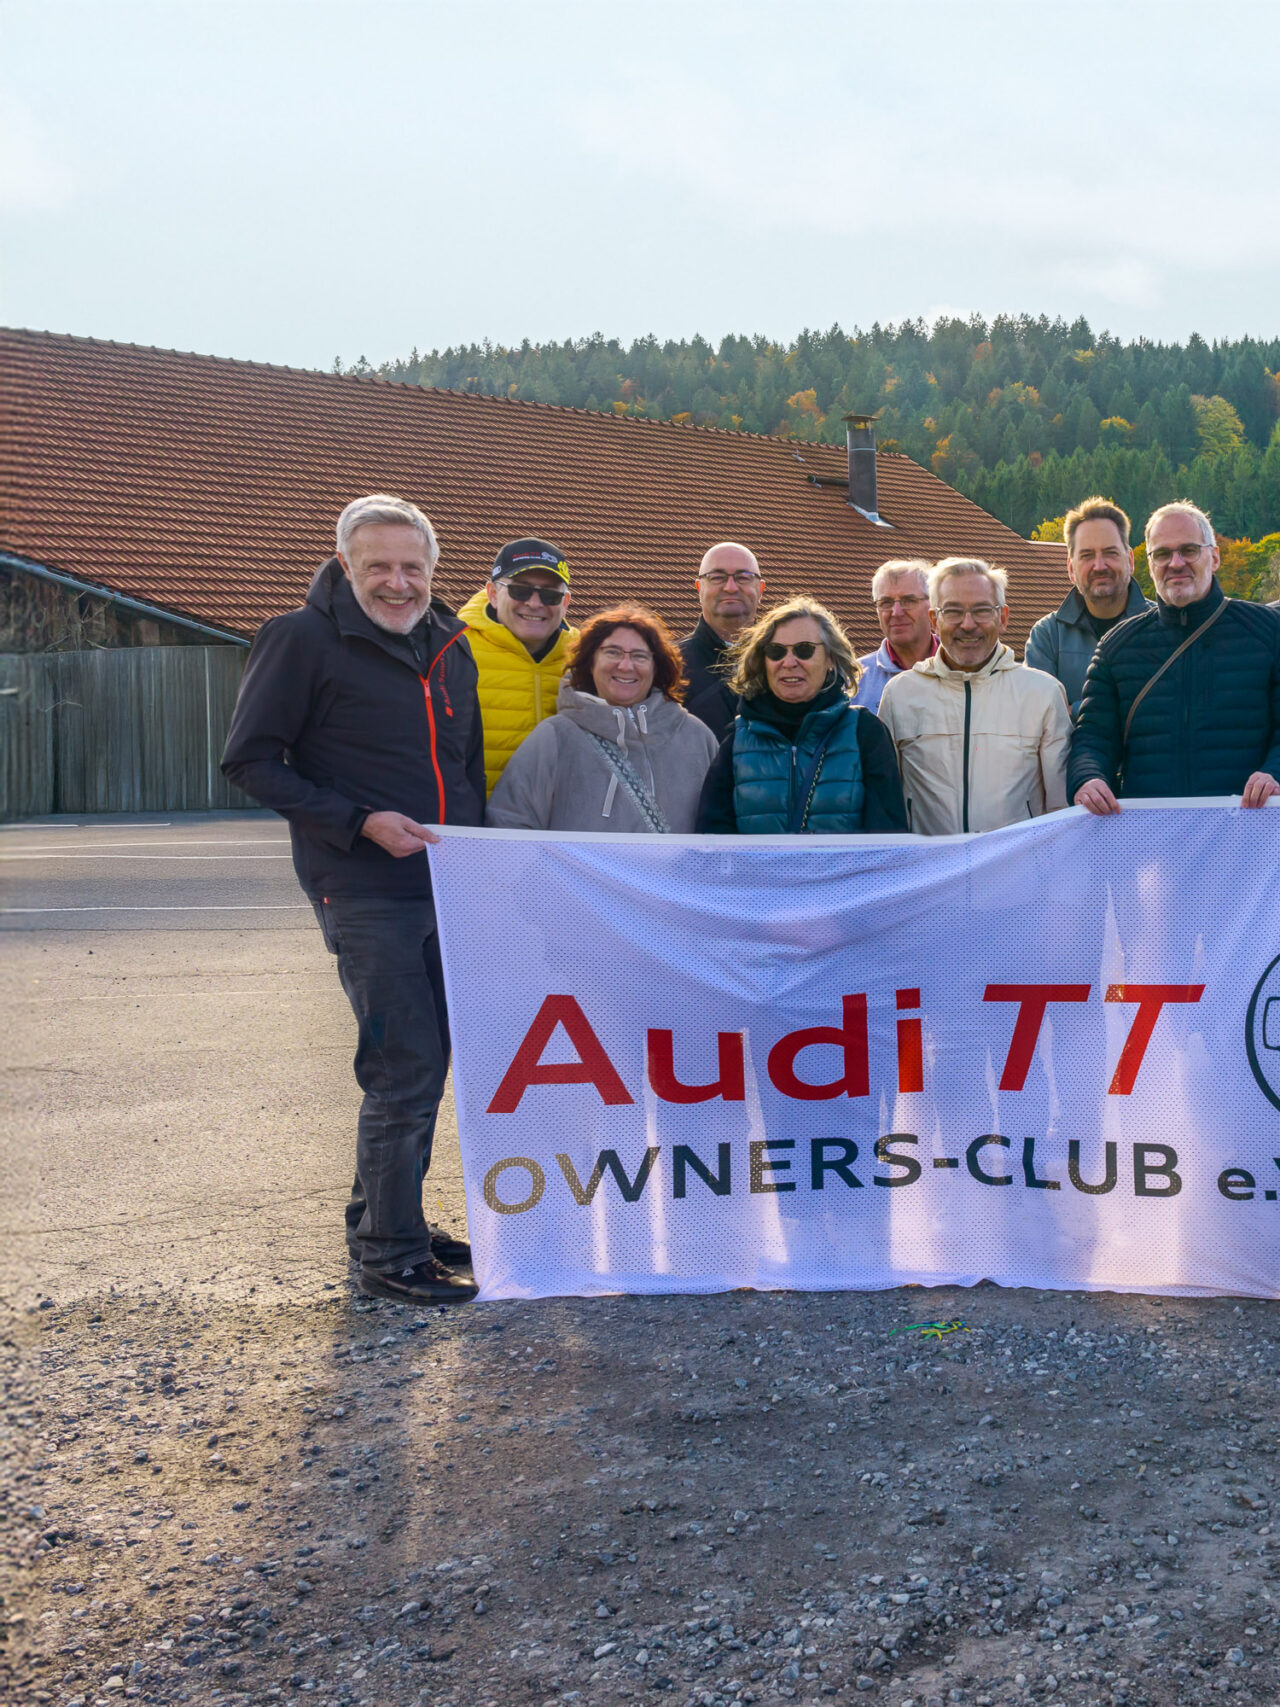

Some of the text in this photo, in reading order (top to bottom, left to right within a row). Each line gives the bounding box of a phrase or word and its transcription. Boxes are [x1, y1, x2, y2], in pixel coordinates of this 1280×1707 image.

[486, 984, 1206, 1114] Audi TT
[483, 1133, 1182, 1215] OWNERS-CLUB
